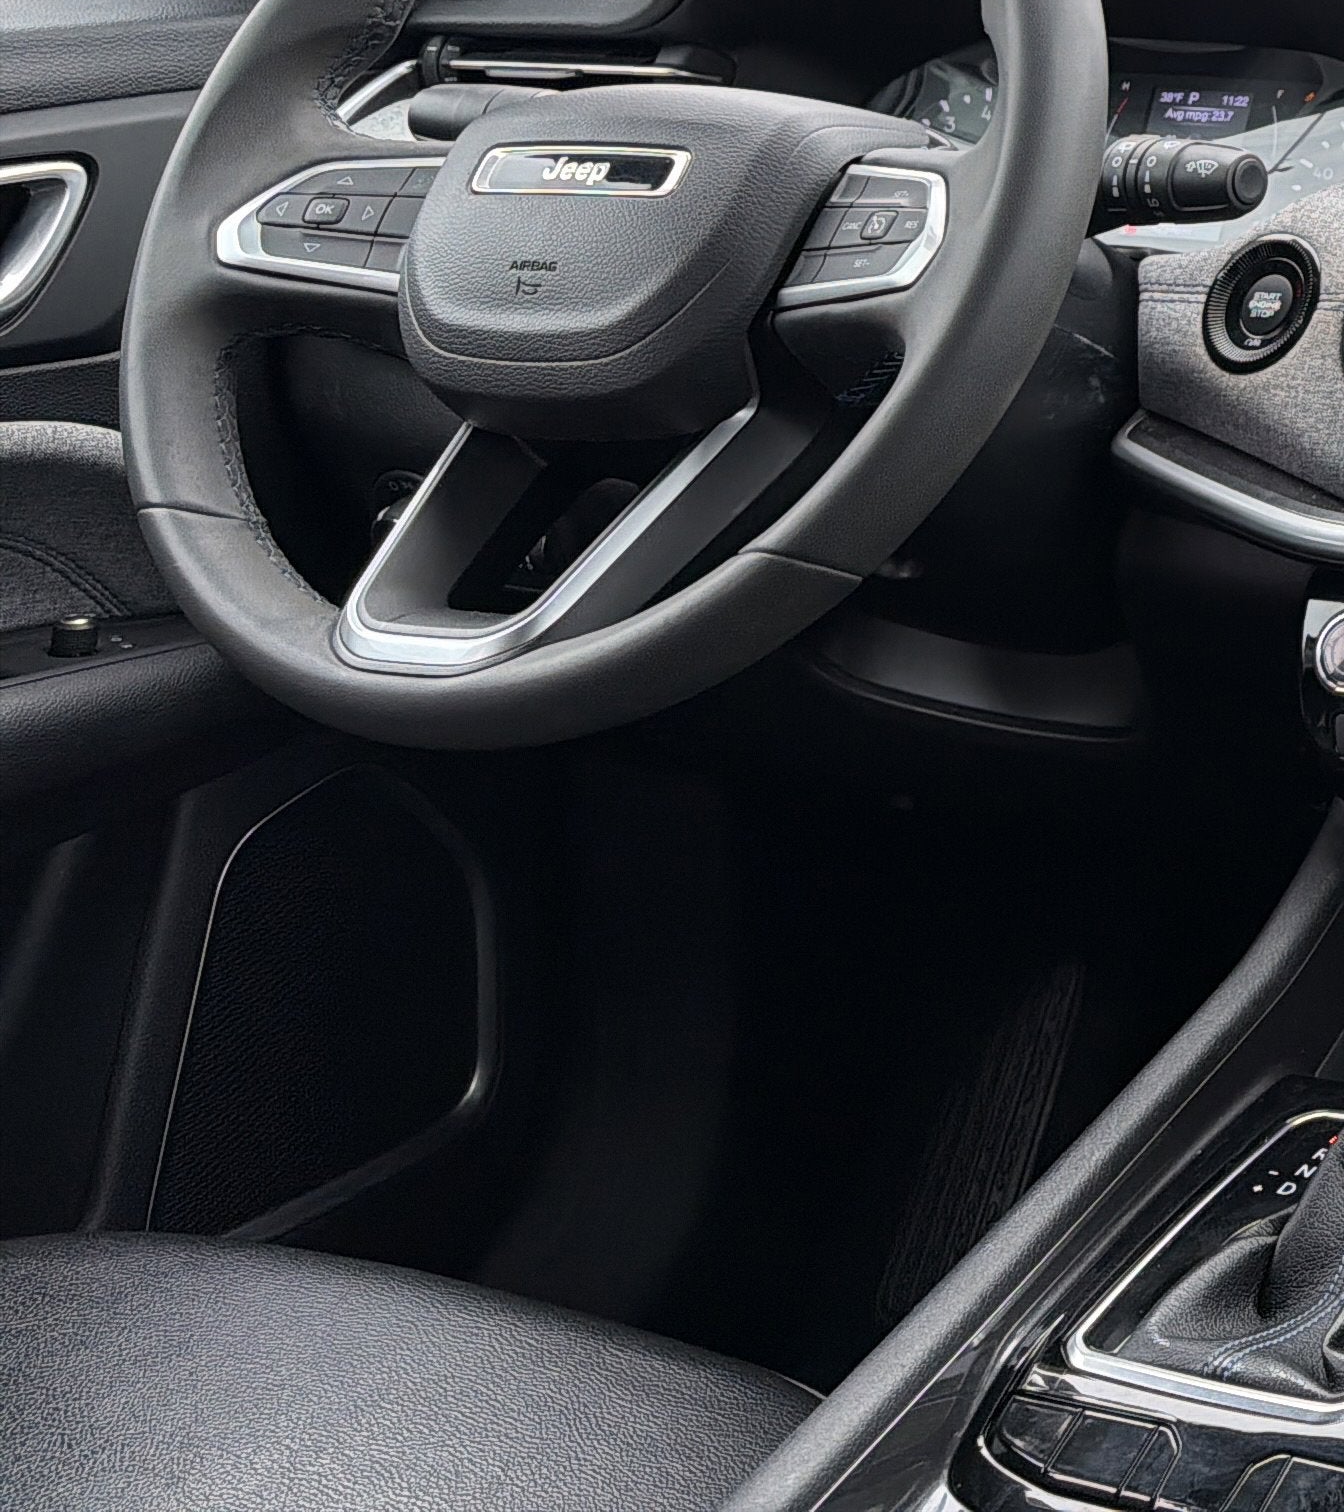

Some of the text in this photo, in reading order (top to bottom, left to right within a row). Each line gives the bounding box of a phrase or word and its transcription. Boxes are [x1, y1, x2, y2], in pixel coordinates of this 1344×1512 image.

[1187, 91, 1200, 104] P
[981, 105, 992, 121] 4
[1165, 111, 1184, 121] Avg
[1211, 110, 1234, 122] 23.7
[943, 116, 956, 133] 3
[542, 156, 612, 186] Jeep
[1313, 167, 1334, 180] 40
[315, 204, 335, 215] OK
[508, 260, 559, 272] AIRBAG
[1294, 1163, 1318, 1178] N
[1276, 1181, 1297, 1196] D
